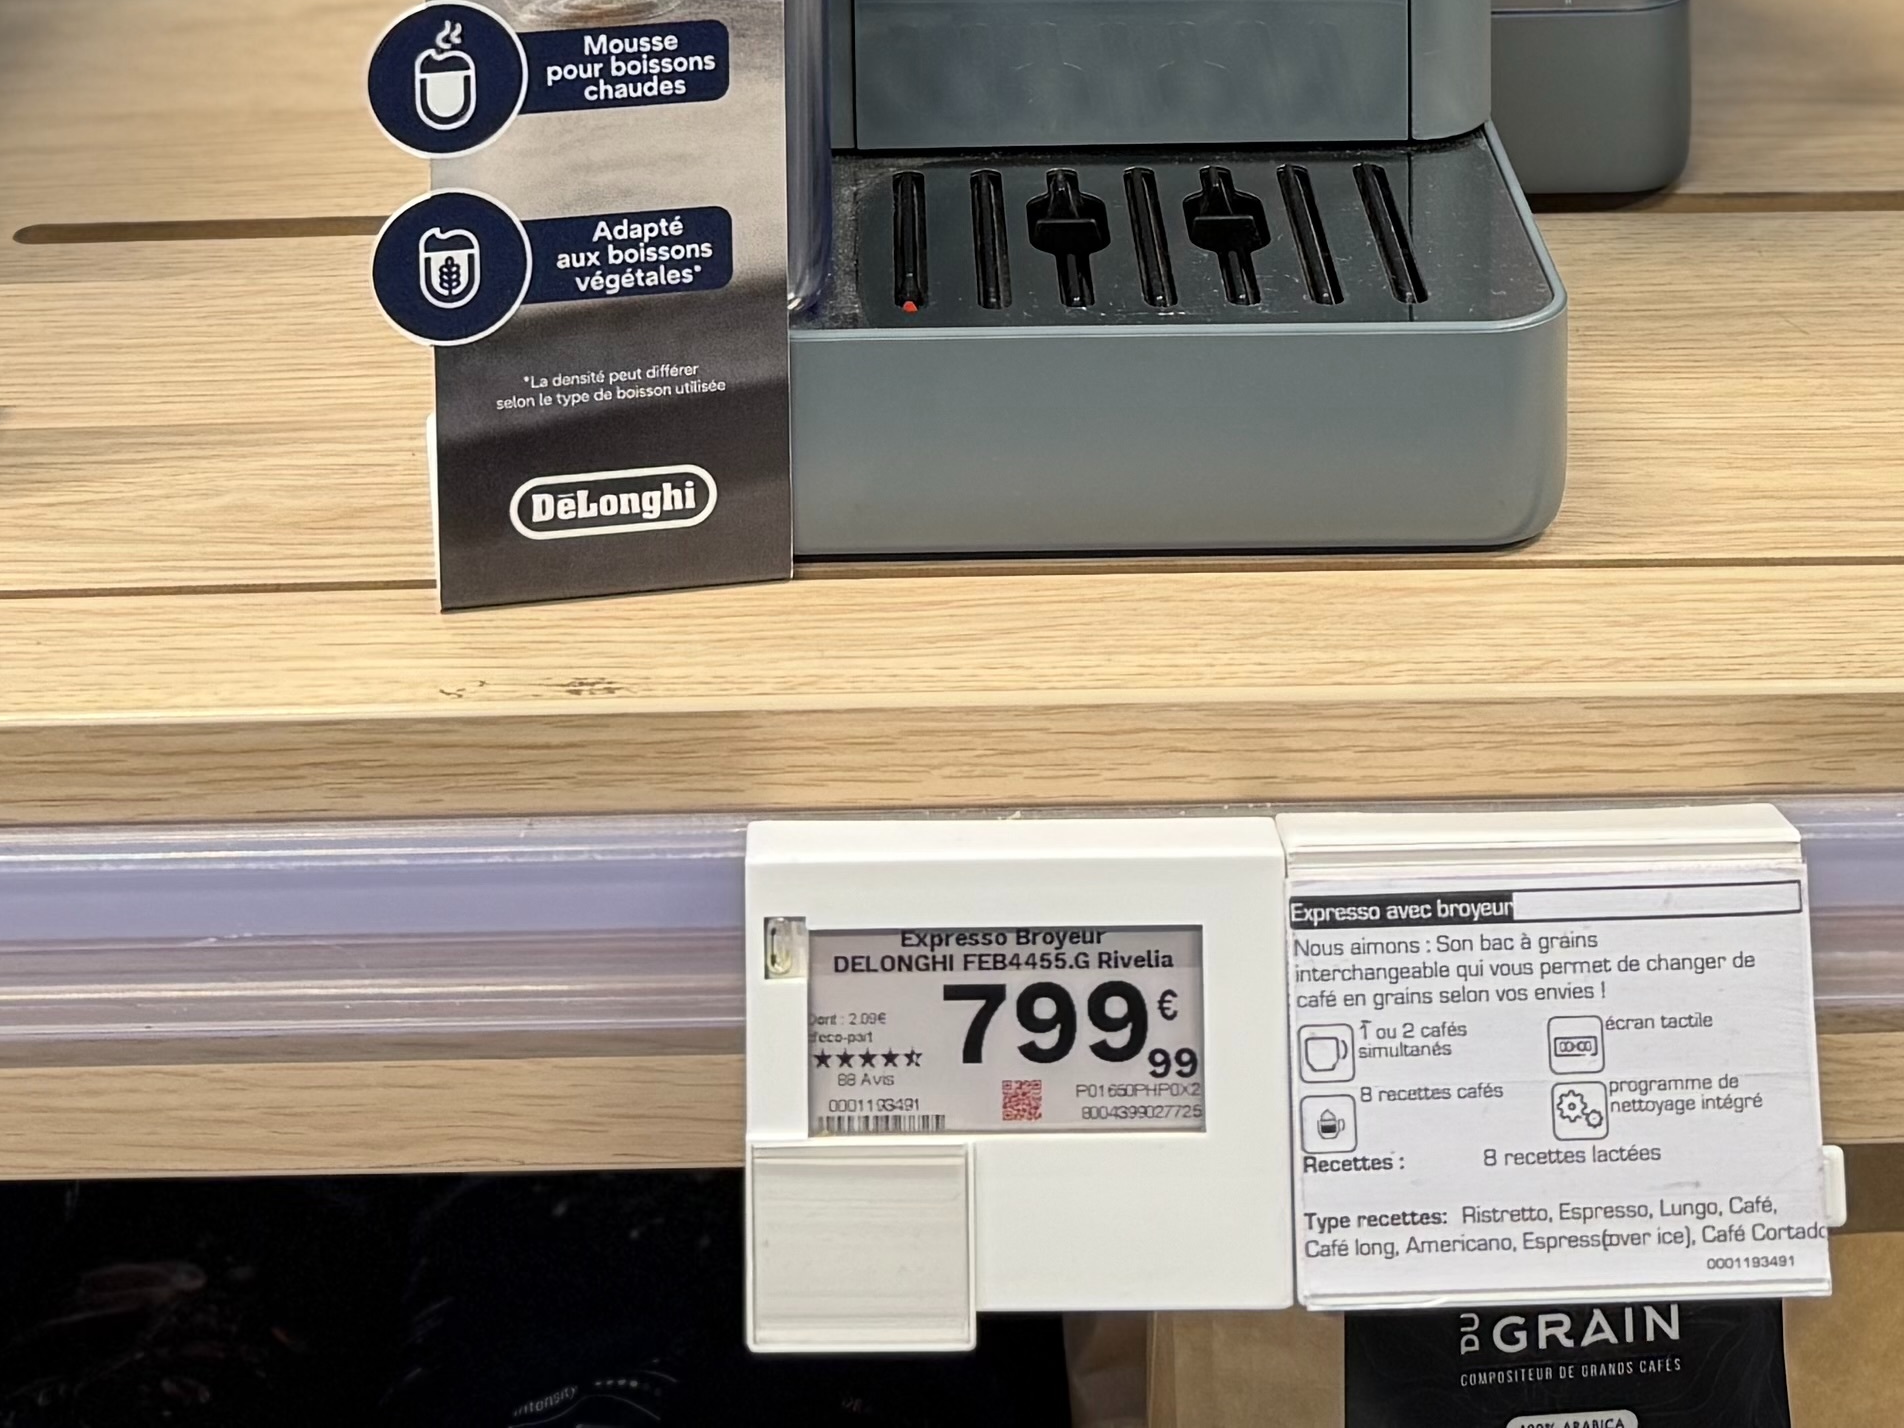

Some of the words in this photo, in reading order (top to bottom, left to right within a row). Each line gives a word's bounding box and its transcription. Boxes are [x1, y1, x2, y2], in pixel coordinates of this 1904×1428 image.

[583, 34, 678, 55] Mousse
[546, 59, 603, 85] pour
[610, 54, 715, 76] boissons
[584, 77, 686, 101] chaudes
[592, 216, 684, 242] Adapté
[557, 249, 600, 269] aux
[608, 241, 713, 265] boissons
[552, 369, 605, 387] densité
[609, 368, 642, 386] peut
[646, 363, 699, 380] différer
[496, 394, 534, 410] selon
[539, 393, 553, 407] le
[556, 389, 590, 407] type
[594, 387, 613, 401] de
[616, 383, 672, 399] boisson
[675, 379, 726, 395] utilisée
[1290, 903, 1380, 923] Expresso
[1387, 900, 1432, 919] avec
[1437, 897, 1514, 919] broyeur
[901, 931, 1008, 951] Expresso
[1015, 929, 1108, 950] Broyeur
[833, 955, 953, 973] DELONGHI
[963, 952, 1089, 971] FEB4455.G
[1097, 950, 1174, 970] Rivelia
[1296, 987, 1336, 1009] café
[1343, 989, 1366, 1005] en
[1373, 984, 1433, 1009] grains
[1439, 982, 1490, 1002] selon
[1496, 985, 1528, 1000] vos
[1534, 982, 1595, 1000] envies
[943, 981, 1148, 1064] 799
[1157, 990, 1178, 1021] €
[1605, 1013, 1655, 1031] écran
[1661, 1011, 1713, 1029] tactile
[1148, 1048, 1198, 1078] 99
[1303, 1154, 1393, 1173] Recettes
[1483, 1149, 1496, 1166] 8
[1504, 1147, 1586, 1166] recettes
[1592, 1144, 1661, 1163] lactées
[1304, 1211, 1350, 1231] Type
[1357, 1208, 1448, 1227] recettes:
[1462, 1205, 1554, 1226] Ristretto,
[1559, 1200, 1652, 1223] Espresso,
[1659, 1197, 1722, 1222] Lungo,
[1728, 1195, 1778, 1216] Café,
[1707, 1254, 1795, 1270] 0001193491
[1460, 1313, 1480, 1355] DU
[1492, 1303, 1680, 1353] GRAIN
[1460, 1366, 1553, 1387] COMPOSITEUR
[1560, 1365, 1575, 1379] DE
[1640, 1357, 1681, 1373] CAFÉS
